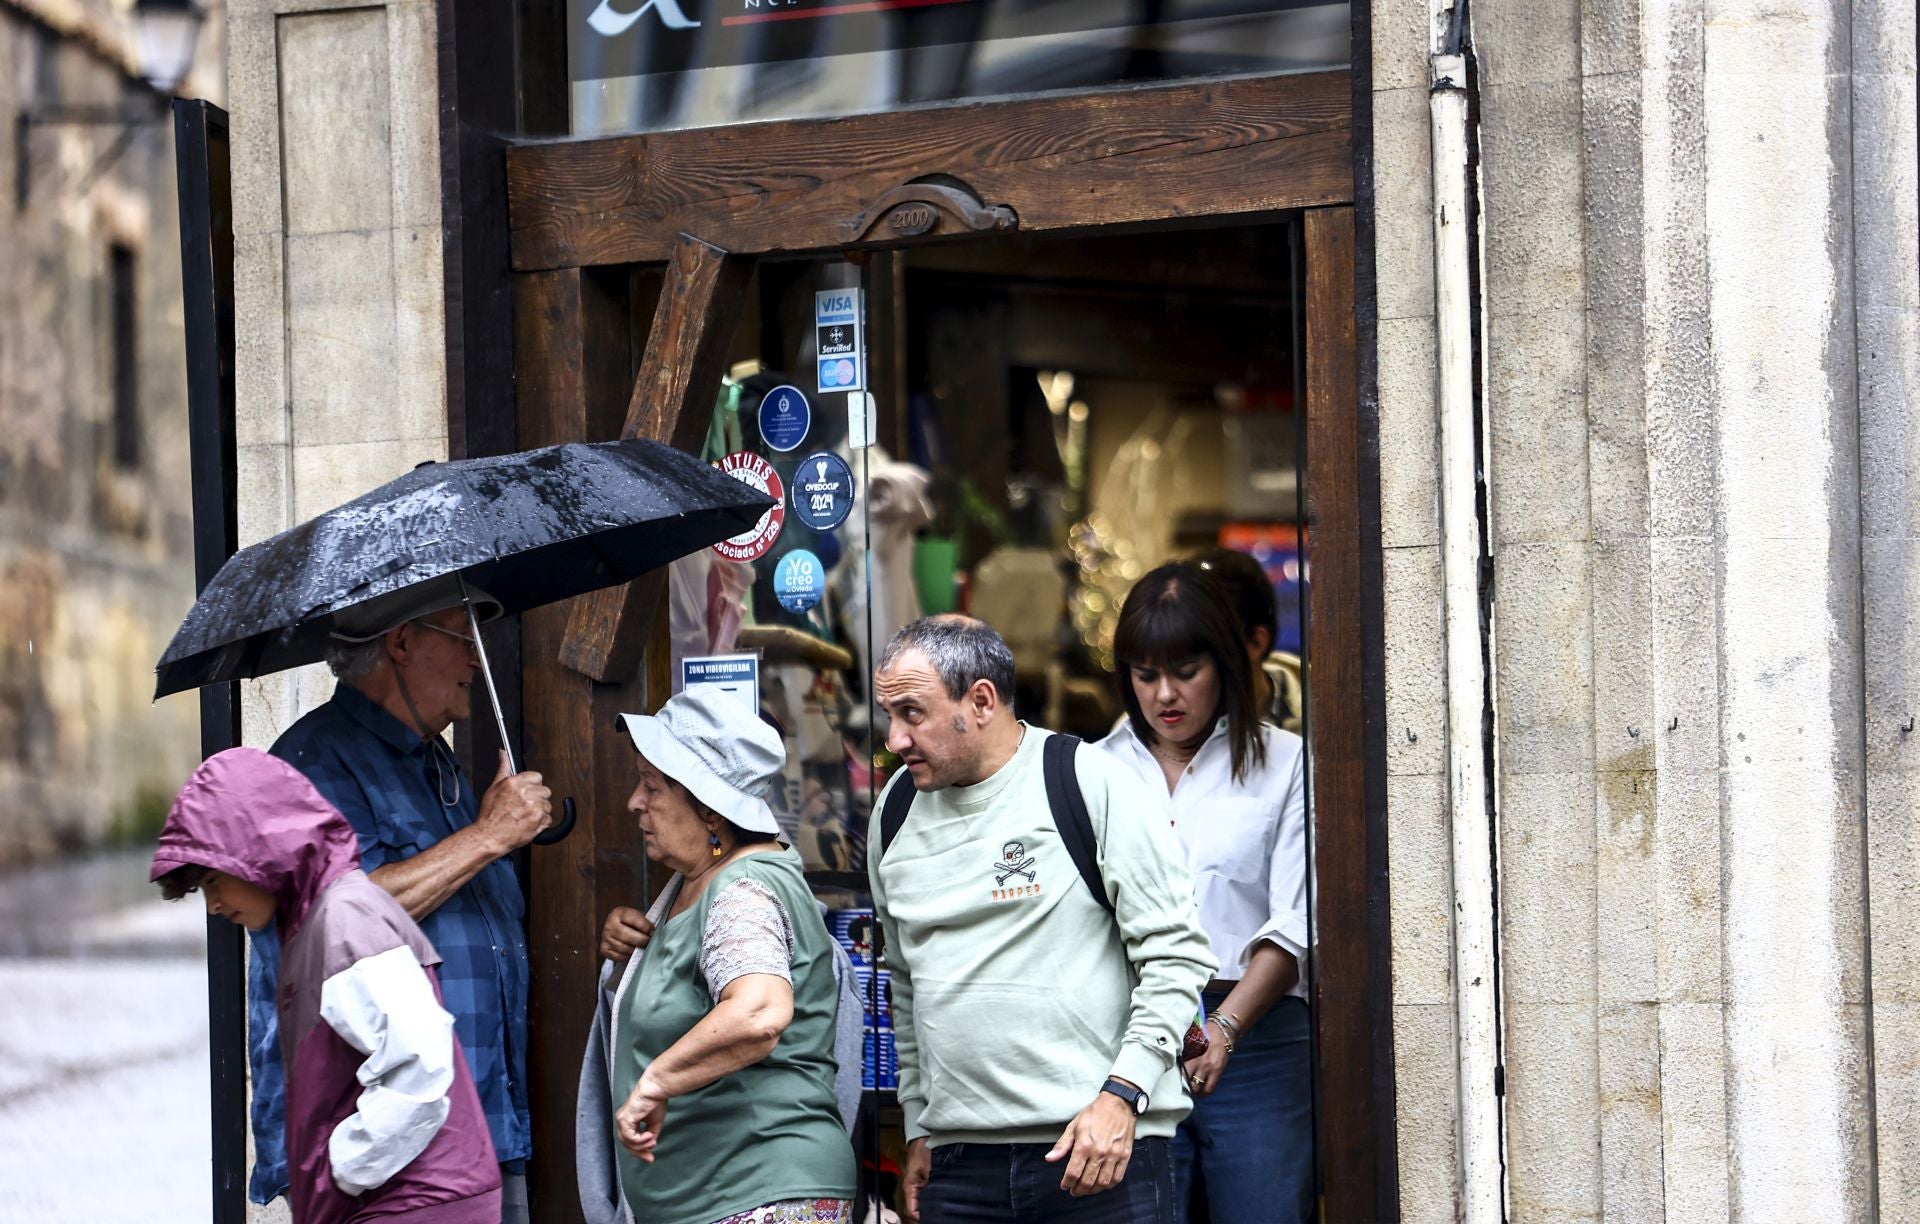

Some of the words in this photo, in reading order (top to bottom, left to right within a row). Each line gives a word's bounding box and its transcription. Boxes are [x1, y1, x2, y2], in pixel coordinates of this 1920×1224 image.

[893, 209, 928, 229] 2000
[822, 296, 852, 312] VISA
[822, 343, 852, 354] ServiRed
[811, 494, 834, 511] 2024
[764, 520, 780, 543] 229
[785, 575, 813, 586] creo
[791, 585, 813, 593] Oviedo
[689, 665, 705, 674] ZONA
[705, 663, 751, 674] VIDEOVIGILADA
[992, 884, 1040, 901] HARPER
